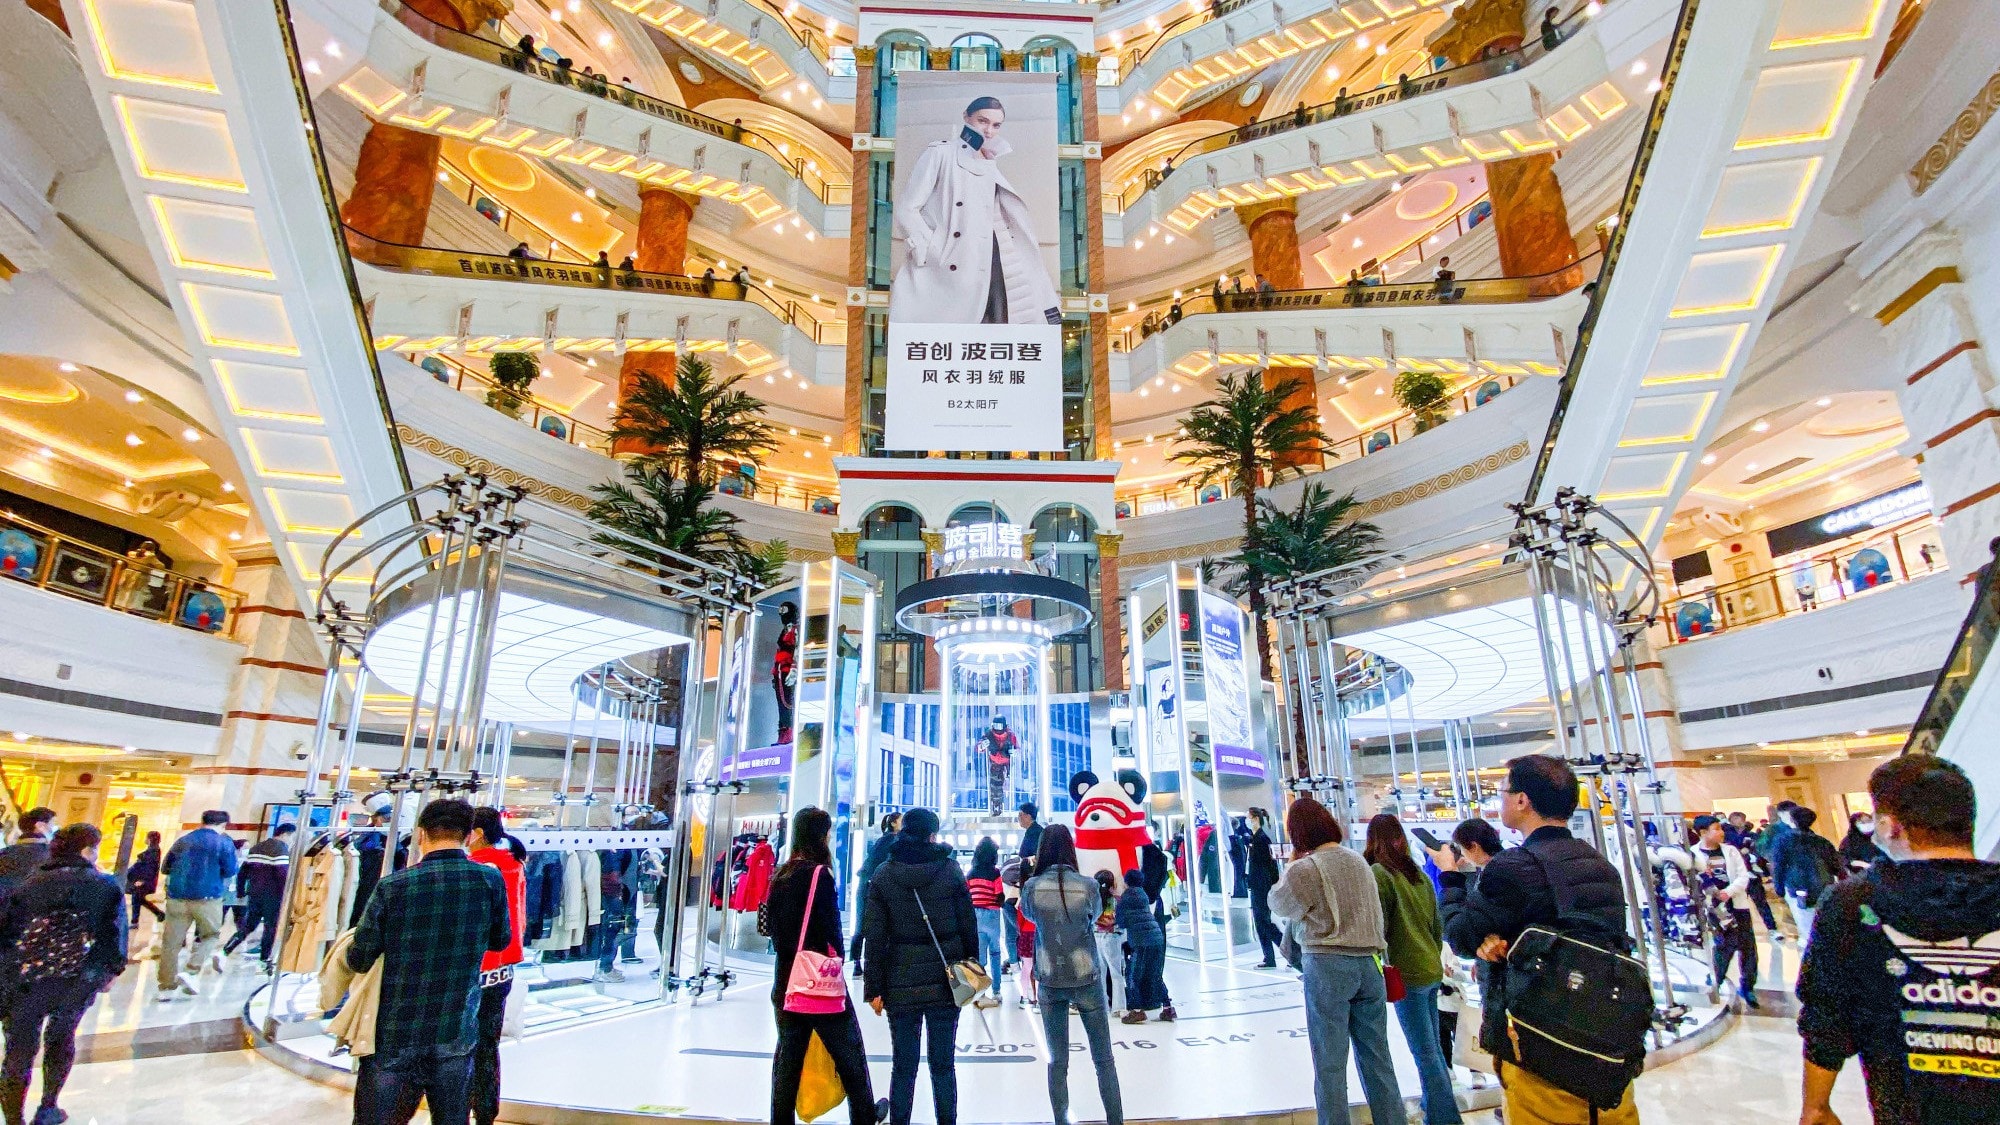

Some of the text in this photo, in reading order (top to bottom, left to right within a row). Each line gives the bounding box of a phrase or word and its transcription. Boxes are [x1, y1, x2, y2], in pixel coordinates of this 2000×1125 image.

[906, 342, 1042, 361] 首创 波司登
[922, 370, 1026, 385] 风衣羽绒服
[947, 400, 999, 410] B2太阳厅
[944, 522, 1023, 551] 波司登
[1937, 1058, 1959, 1070] XL
